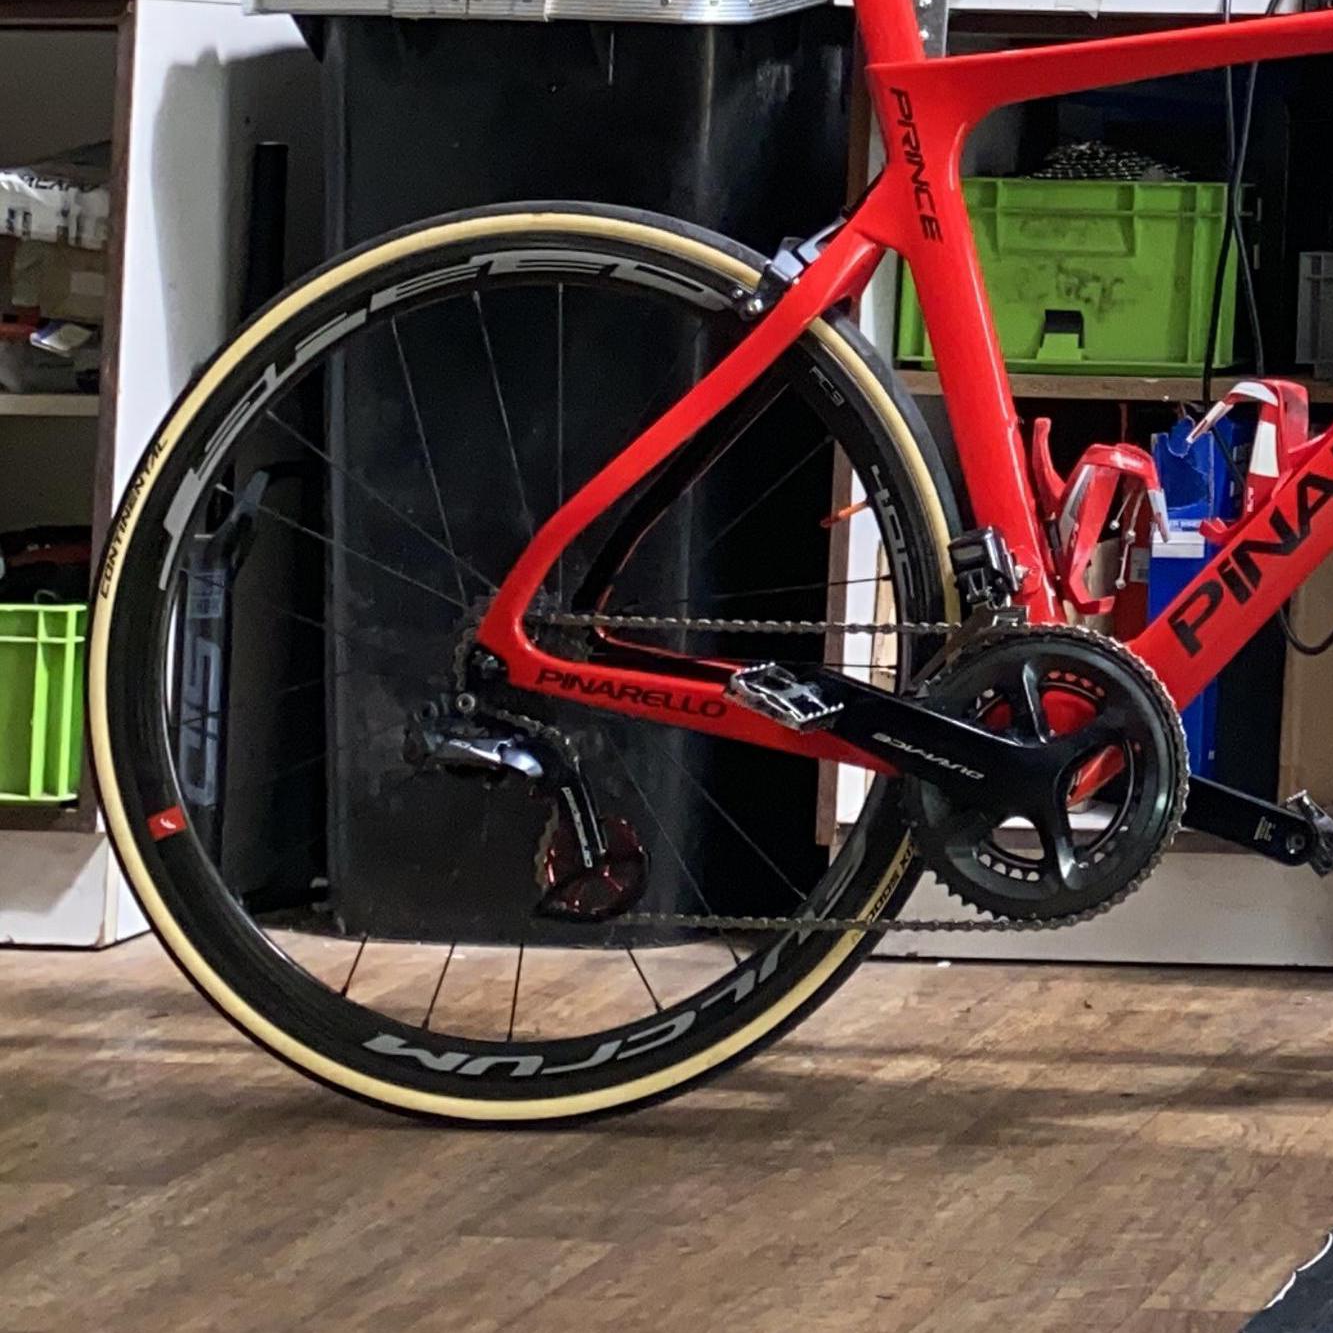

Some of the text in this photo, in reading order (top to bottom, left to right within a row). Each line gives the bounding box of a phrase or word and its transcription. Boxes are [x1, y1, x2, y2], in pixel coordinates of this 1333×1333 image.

[890, 86, 943, 245] PRINCE
[98, 436, 168, 599] CONTINENTAL
[534, 666, 728, 720] PINARELLO
